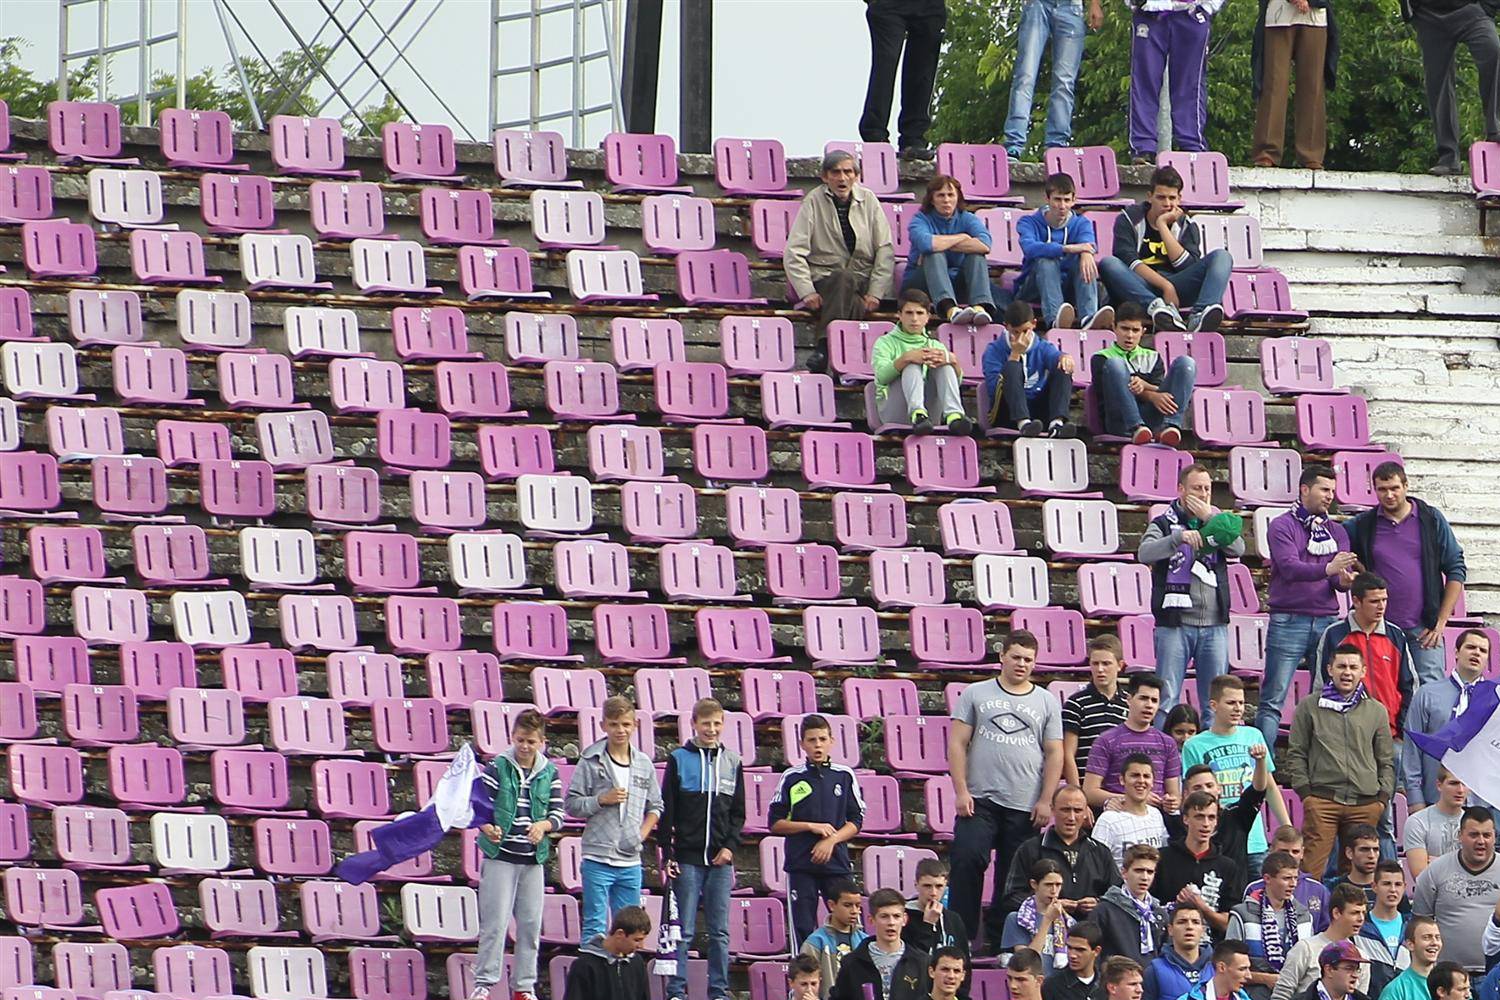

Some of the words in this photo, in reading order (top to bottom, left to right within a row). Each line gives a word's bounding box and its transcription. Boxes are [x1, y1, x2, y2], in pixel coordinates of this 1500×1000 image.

[978, 699, 1011, 714] FREE
[1016, 704, 1041, 722] FALL
[978, 724, 1036, 746] SKYDIVING
[1220, 784, 1241, 798] LIFE
